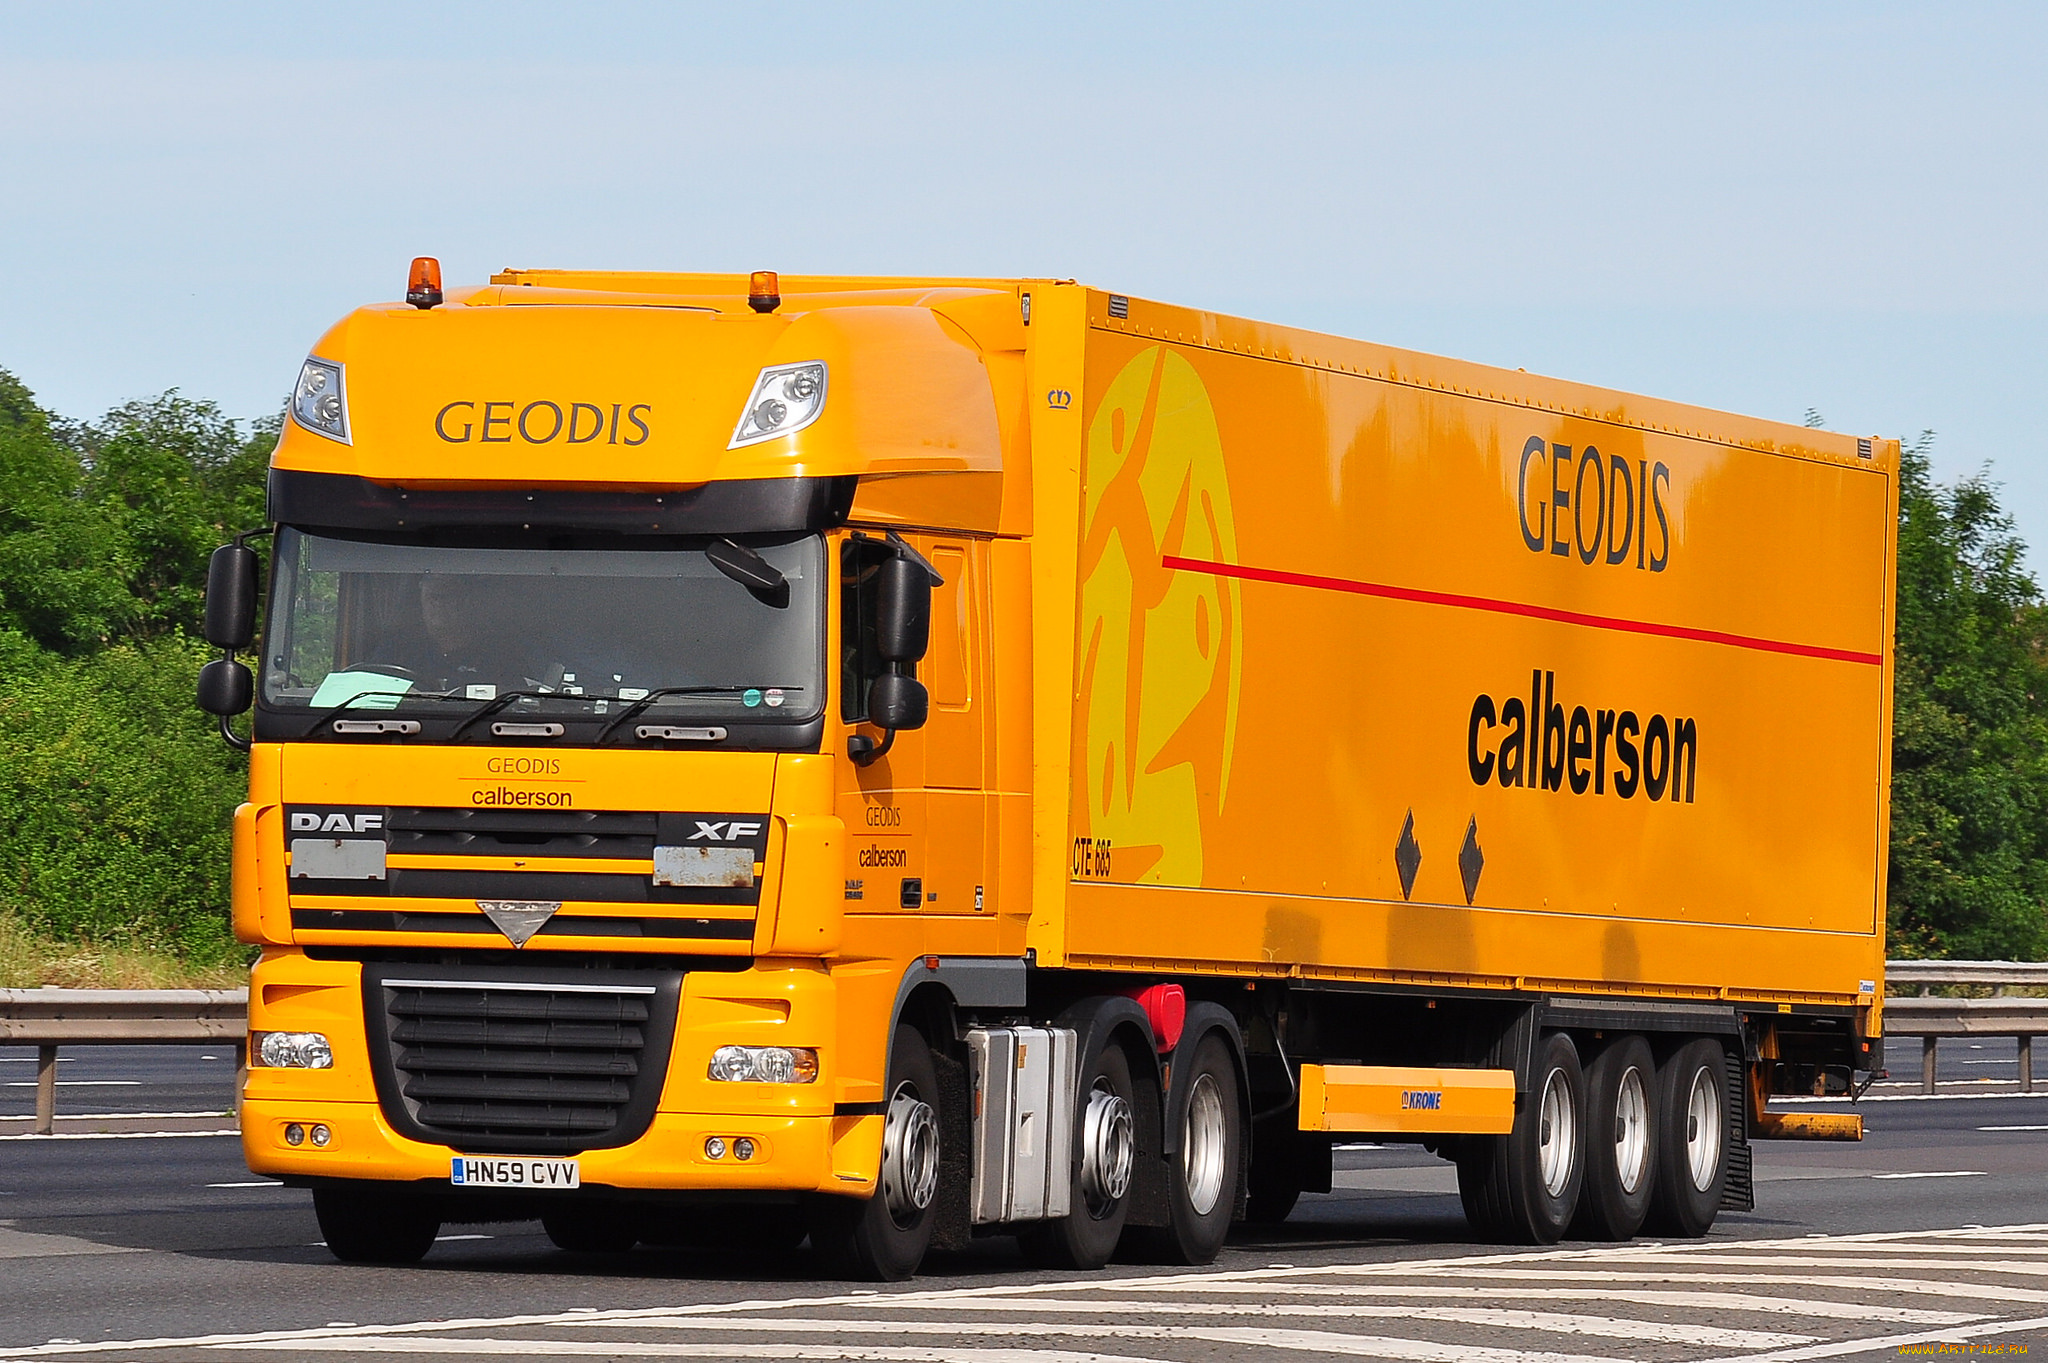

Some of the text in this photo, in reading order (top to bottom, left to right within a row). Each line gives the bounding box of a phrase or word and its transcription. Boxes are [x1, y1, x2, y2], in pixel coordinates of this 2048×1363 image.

[434, 400, 651, 446] GEODIS
[1519, 435, 1671, 573] GEODIS
[1468, 669, 1697, 804] calberson
[487, 757, 561, 775] GEODIS
[471, 787, 572, 808] calberson
[290, 812, 383, 833] DAF
[866, 806, 901, 827] GEODIS
[686, 821, 762, 841] XF
[858, 844, 907, 868] calberson
[1095, 840, 1111, 877] 685
[1409, 1091, 1442, 1110] KRONE
[466, 1161, 524, 1183] HN59
